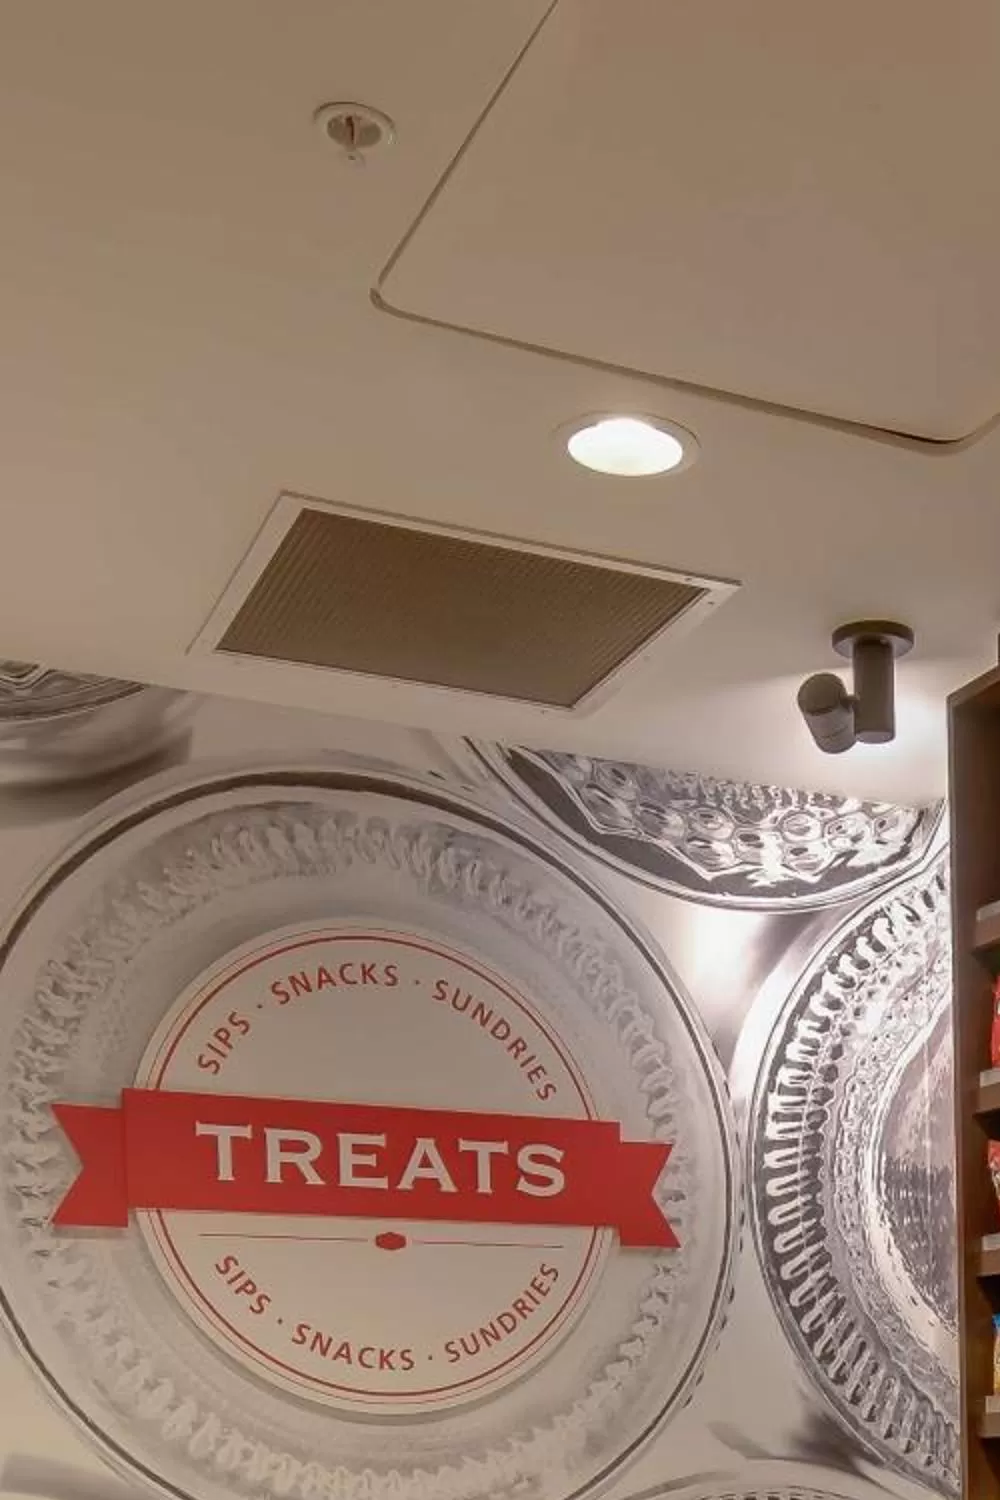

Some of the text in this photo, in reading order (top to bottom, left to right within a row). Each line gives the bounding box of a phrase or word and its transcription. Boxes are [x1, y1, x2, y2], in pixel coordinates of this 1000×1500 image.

[196, 961, 557, 1102] SIPS SNACKS SUNDRIES
[194, 1120, 568, 1198] TREATS
[214, 1253, 561, 1372] SIPS SNACKS SUNDRIES
